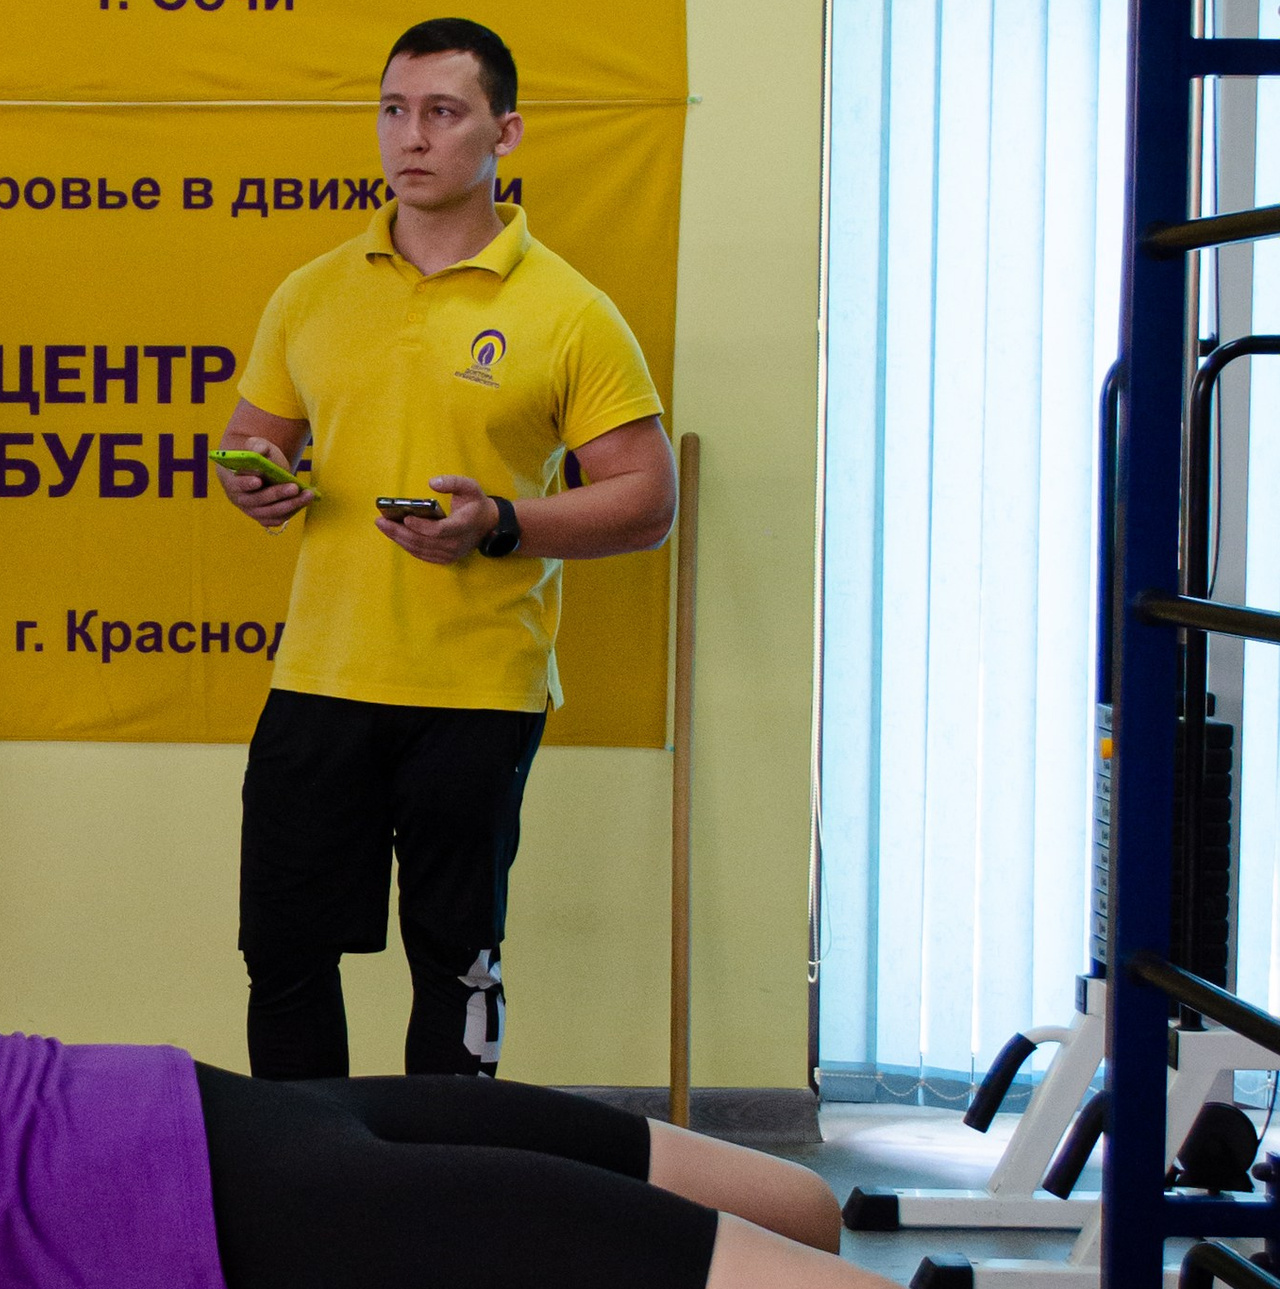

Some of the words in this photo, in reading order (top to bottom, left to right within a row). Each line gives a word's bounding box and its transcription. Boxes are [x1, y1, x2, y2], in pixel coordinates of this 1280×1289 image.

[183, 178, 215, 211] в
[232, 178, 523, 219] движи
[16, 620, 45, 653] г.
[66, 609, 286, 665] Красно
